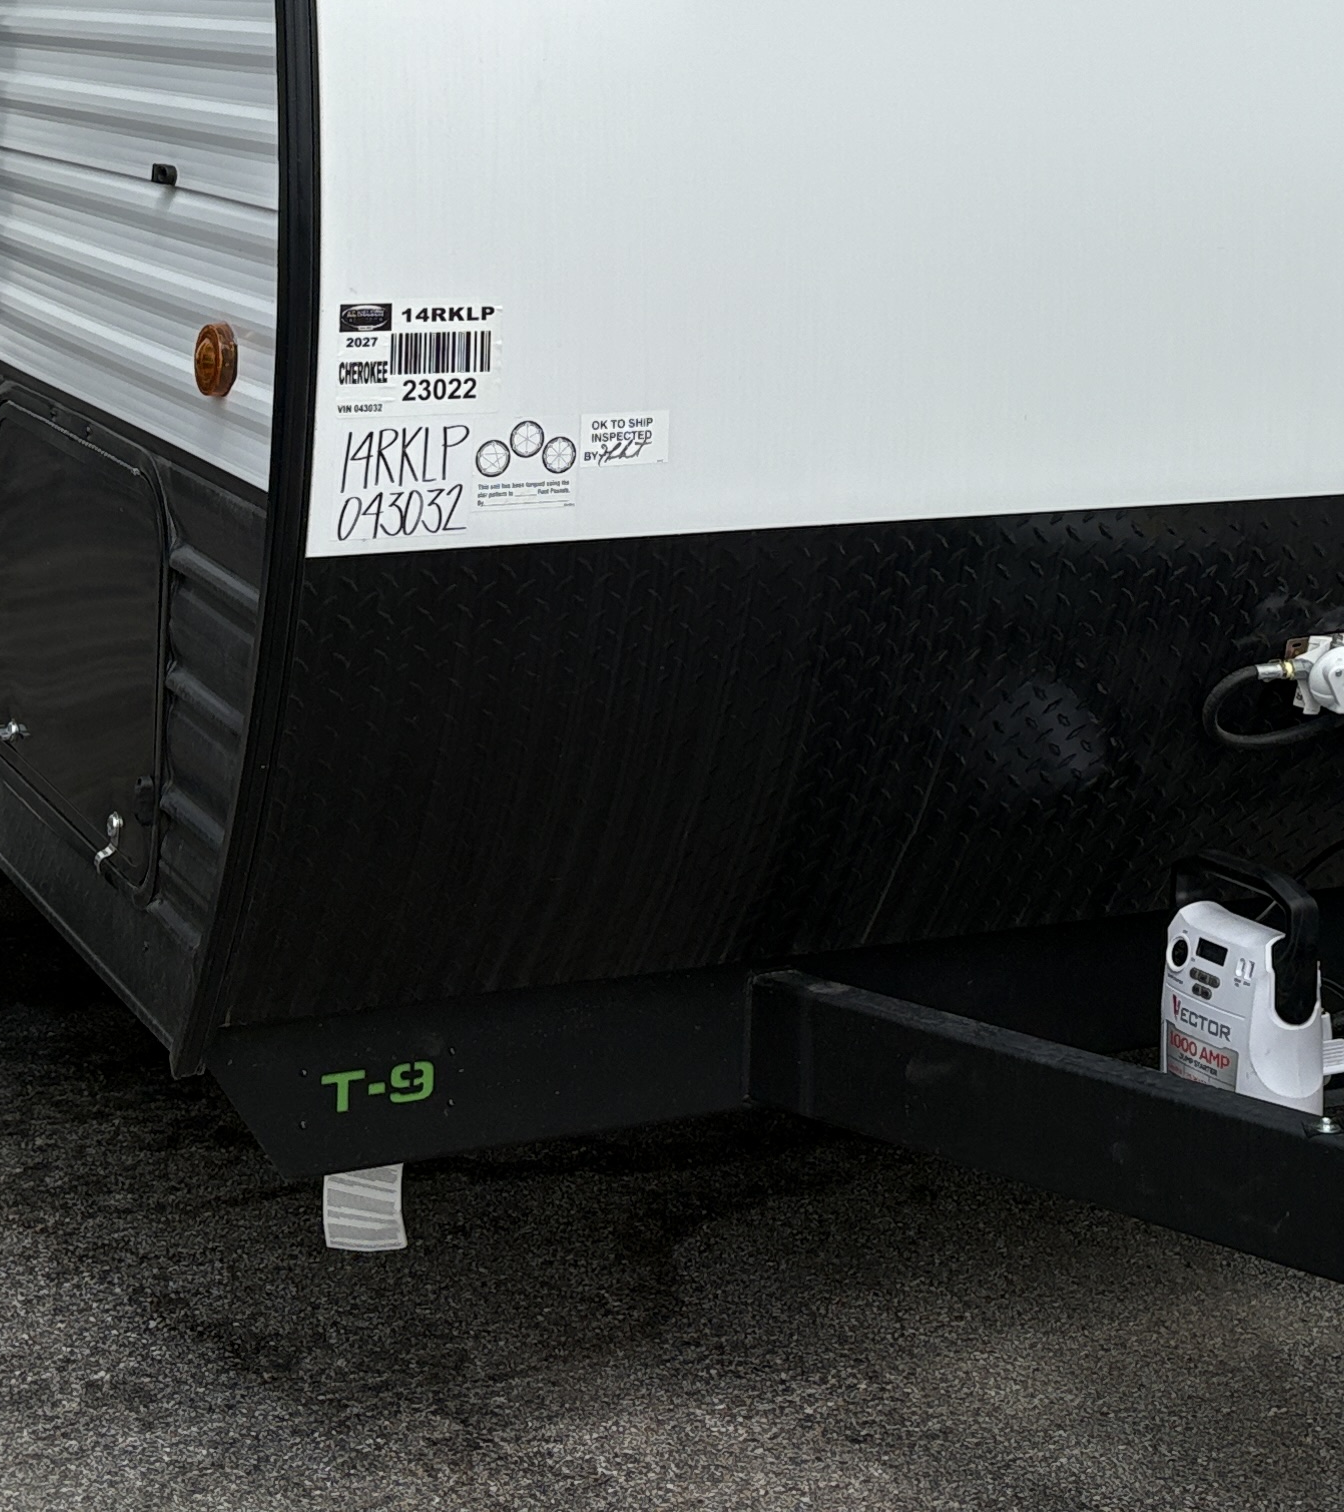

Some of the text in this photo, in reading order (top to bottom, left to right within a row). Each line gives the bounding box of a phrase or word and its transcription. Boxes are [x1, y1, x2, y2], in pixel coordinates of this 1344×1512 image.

[402, 306, 495, 323] 14RKLP
[346, 337, 378, 348] 2027
[339, 361, 388, 385] CHEROKEE
[402, 377, 477, 402] 23022
[337, 403, 383, 414] VIN 043032
[592, 417, 653, 431] OK TO SHIP
[592, 430, 653, 444] INSPECTED
[340, 425, 470, 493] 14RKLP
[584, 451, 598, 461] BY
[338, 484, 467, 541] 043032
[1173, 994, 1231, 1042] VECTOR
[1170, 1031, 1197, 1056] 1000
[1199, 1047, 1231, 1069] AMP
[320, 1060, 435, 1113] T-9
